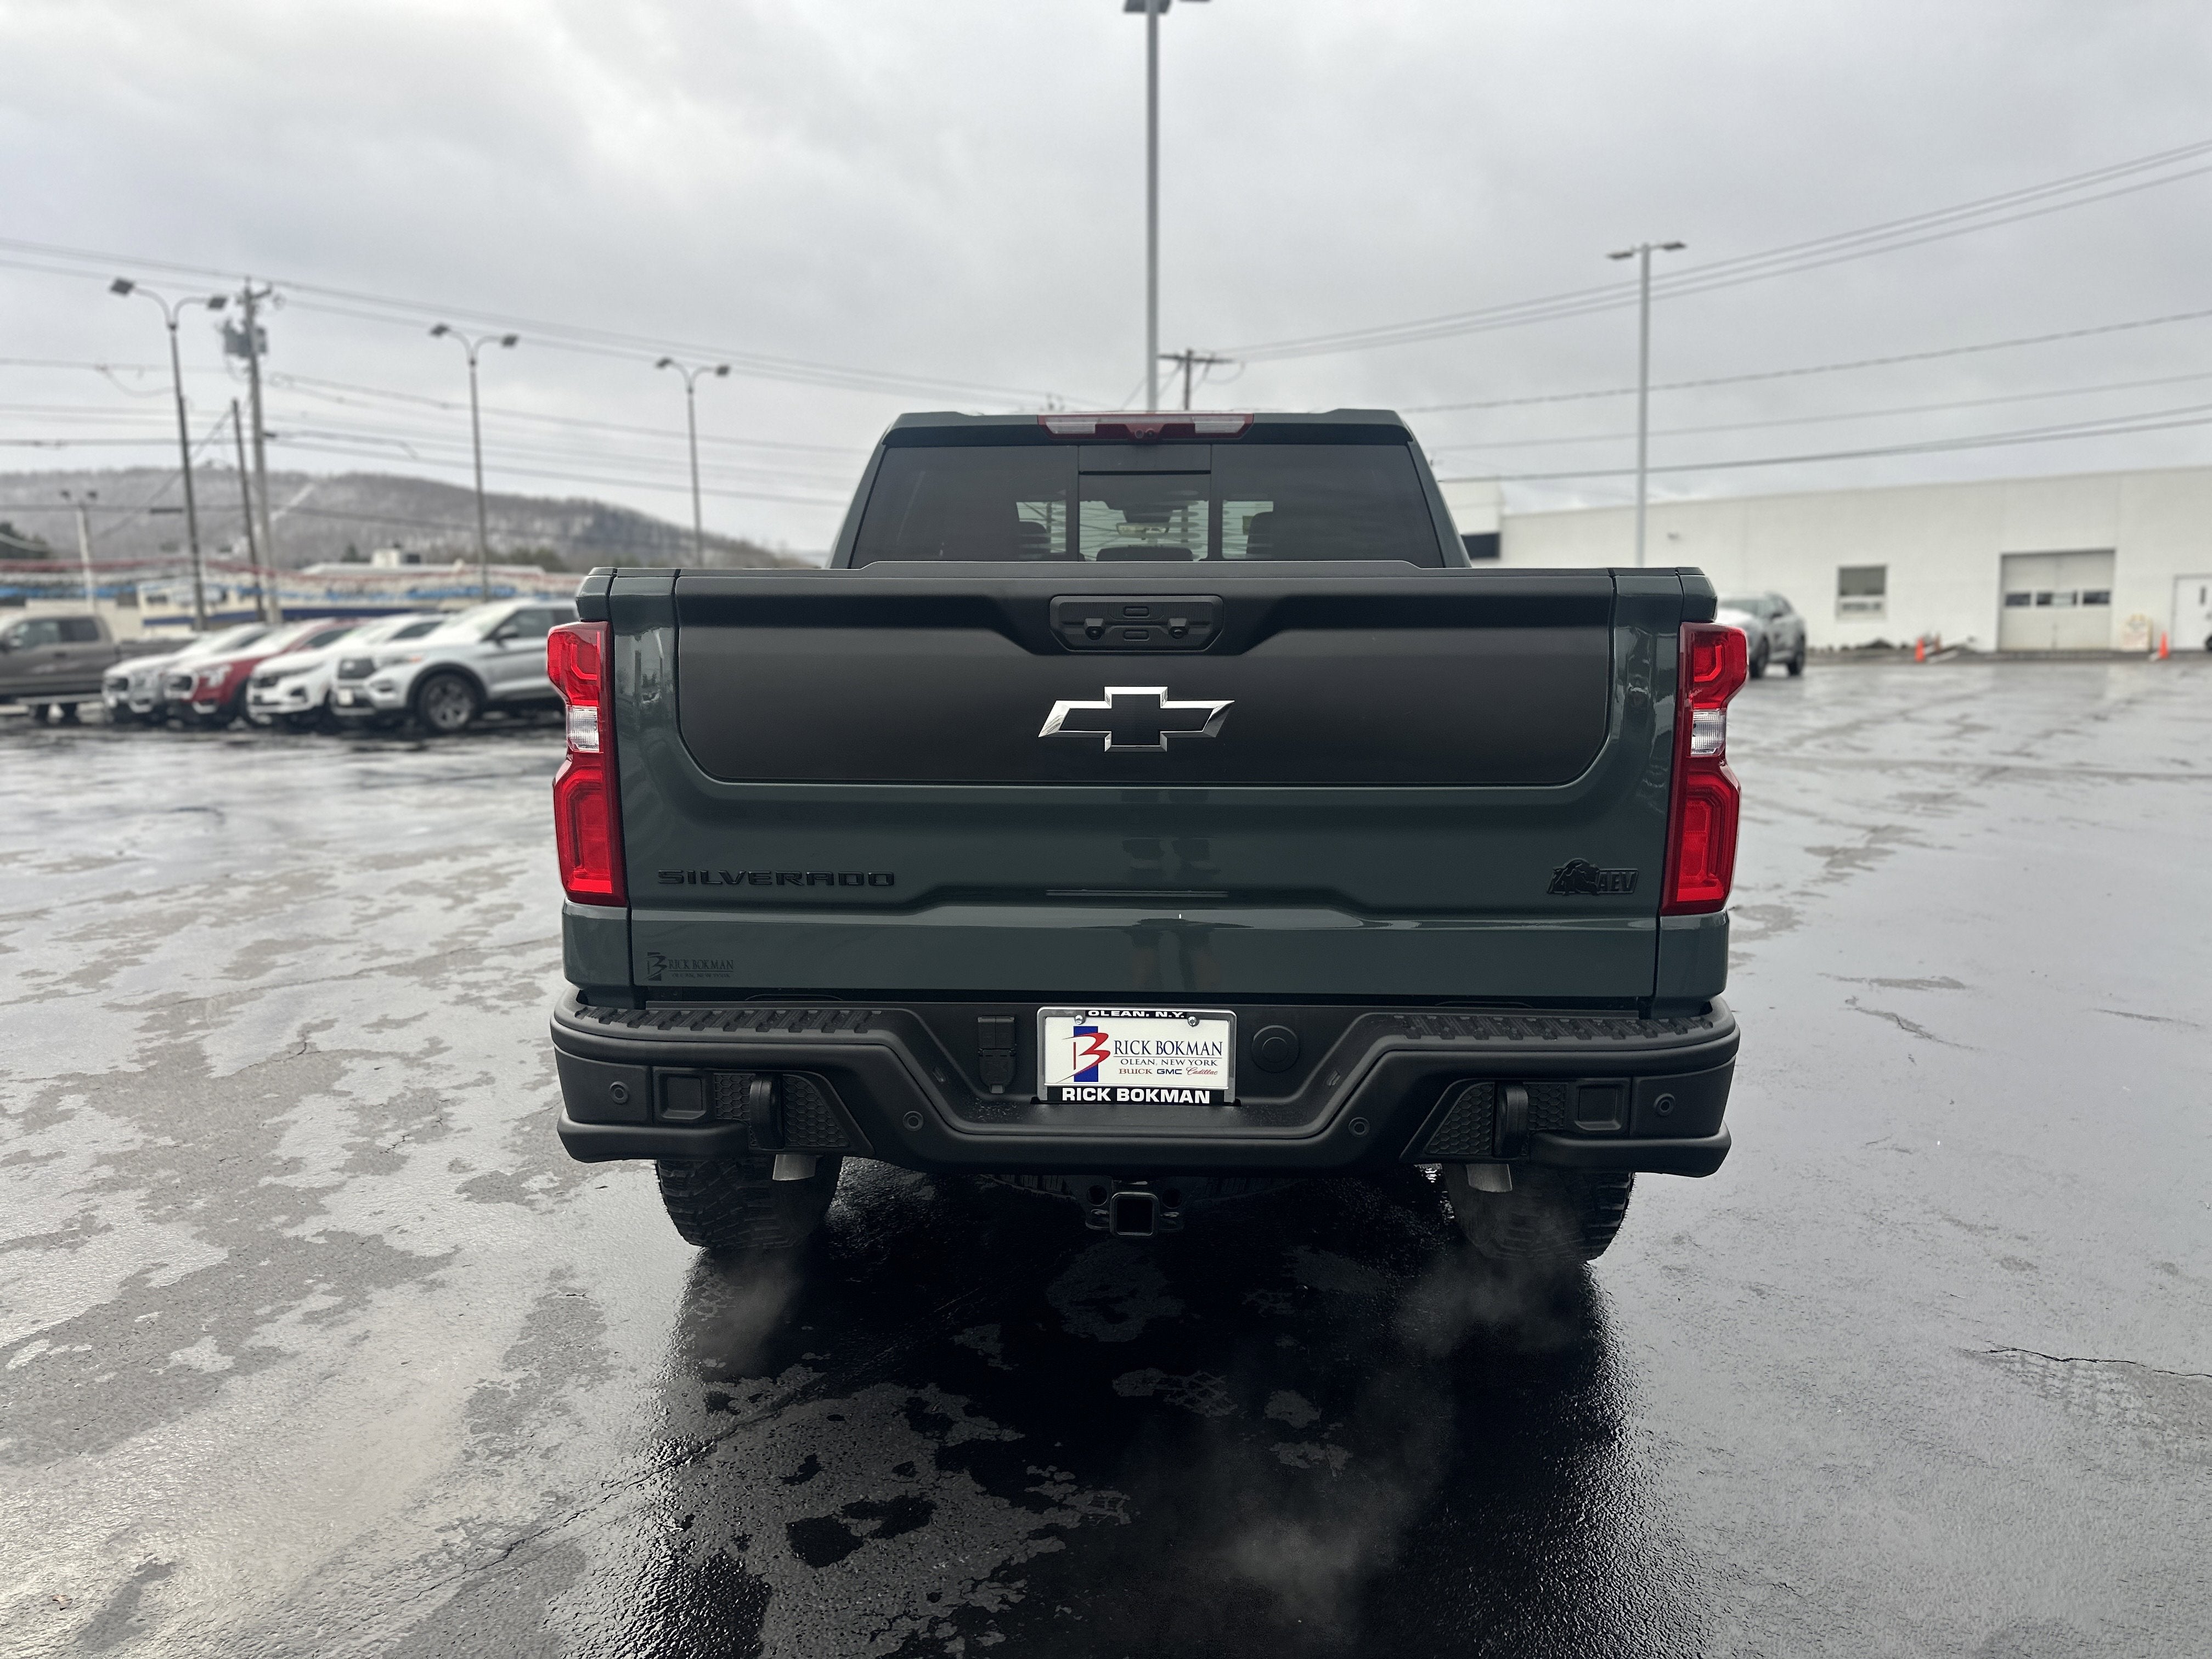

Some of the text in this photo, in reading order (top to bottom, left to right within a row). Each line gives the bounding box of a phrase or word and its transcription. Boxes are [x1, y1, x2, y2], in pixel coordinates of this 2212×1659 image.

[658, 869, 895, 886] SILVERADO
[1596, 871, 1635, 891] AEV
[668, 960, 733, 970] RICK BOKMAN
[1114, 1040, 1223, 1056] RICK BOKMAN
[1186, 1066, 1218, 1075] Cadillac
[1062, 1087, 1210, 1104] RICK BOKMAN
